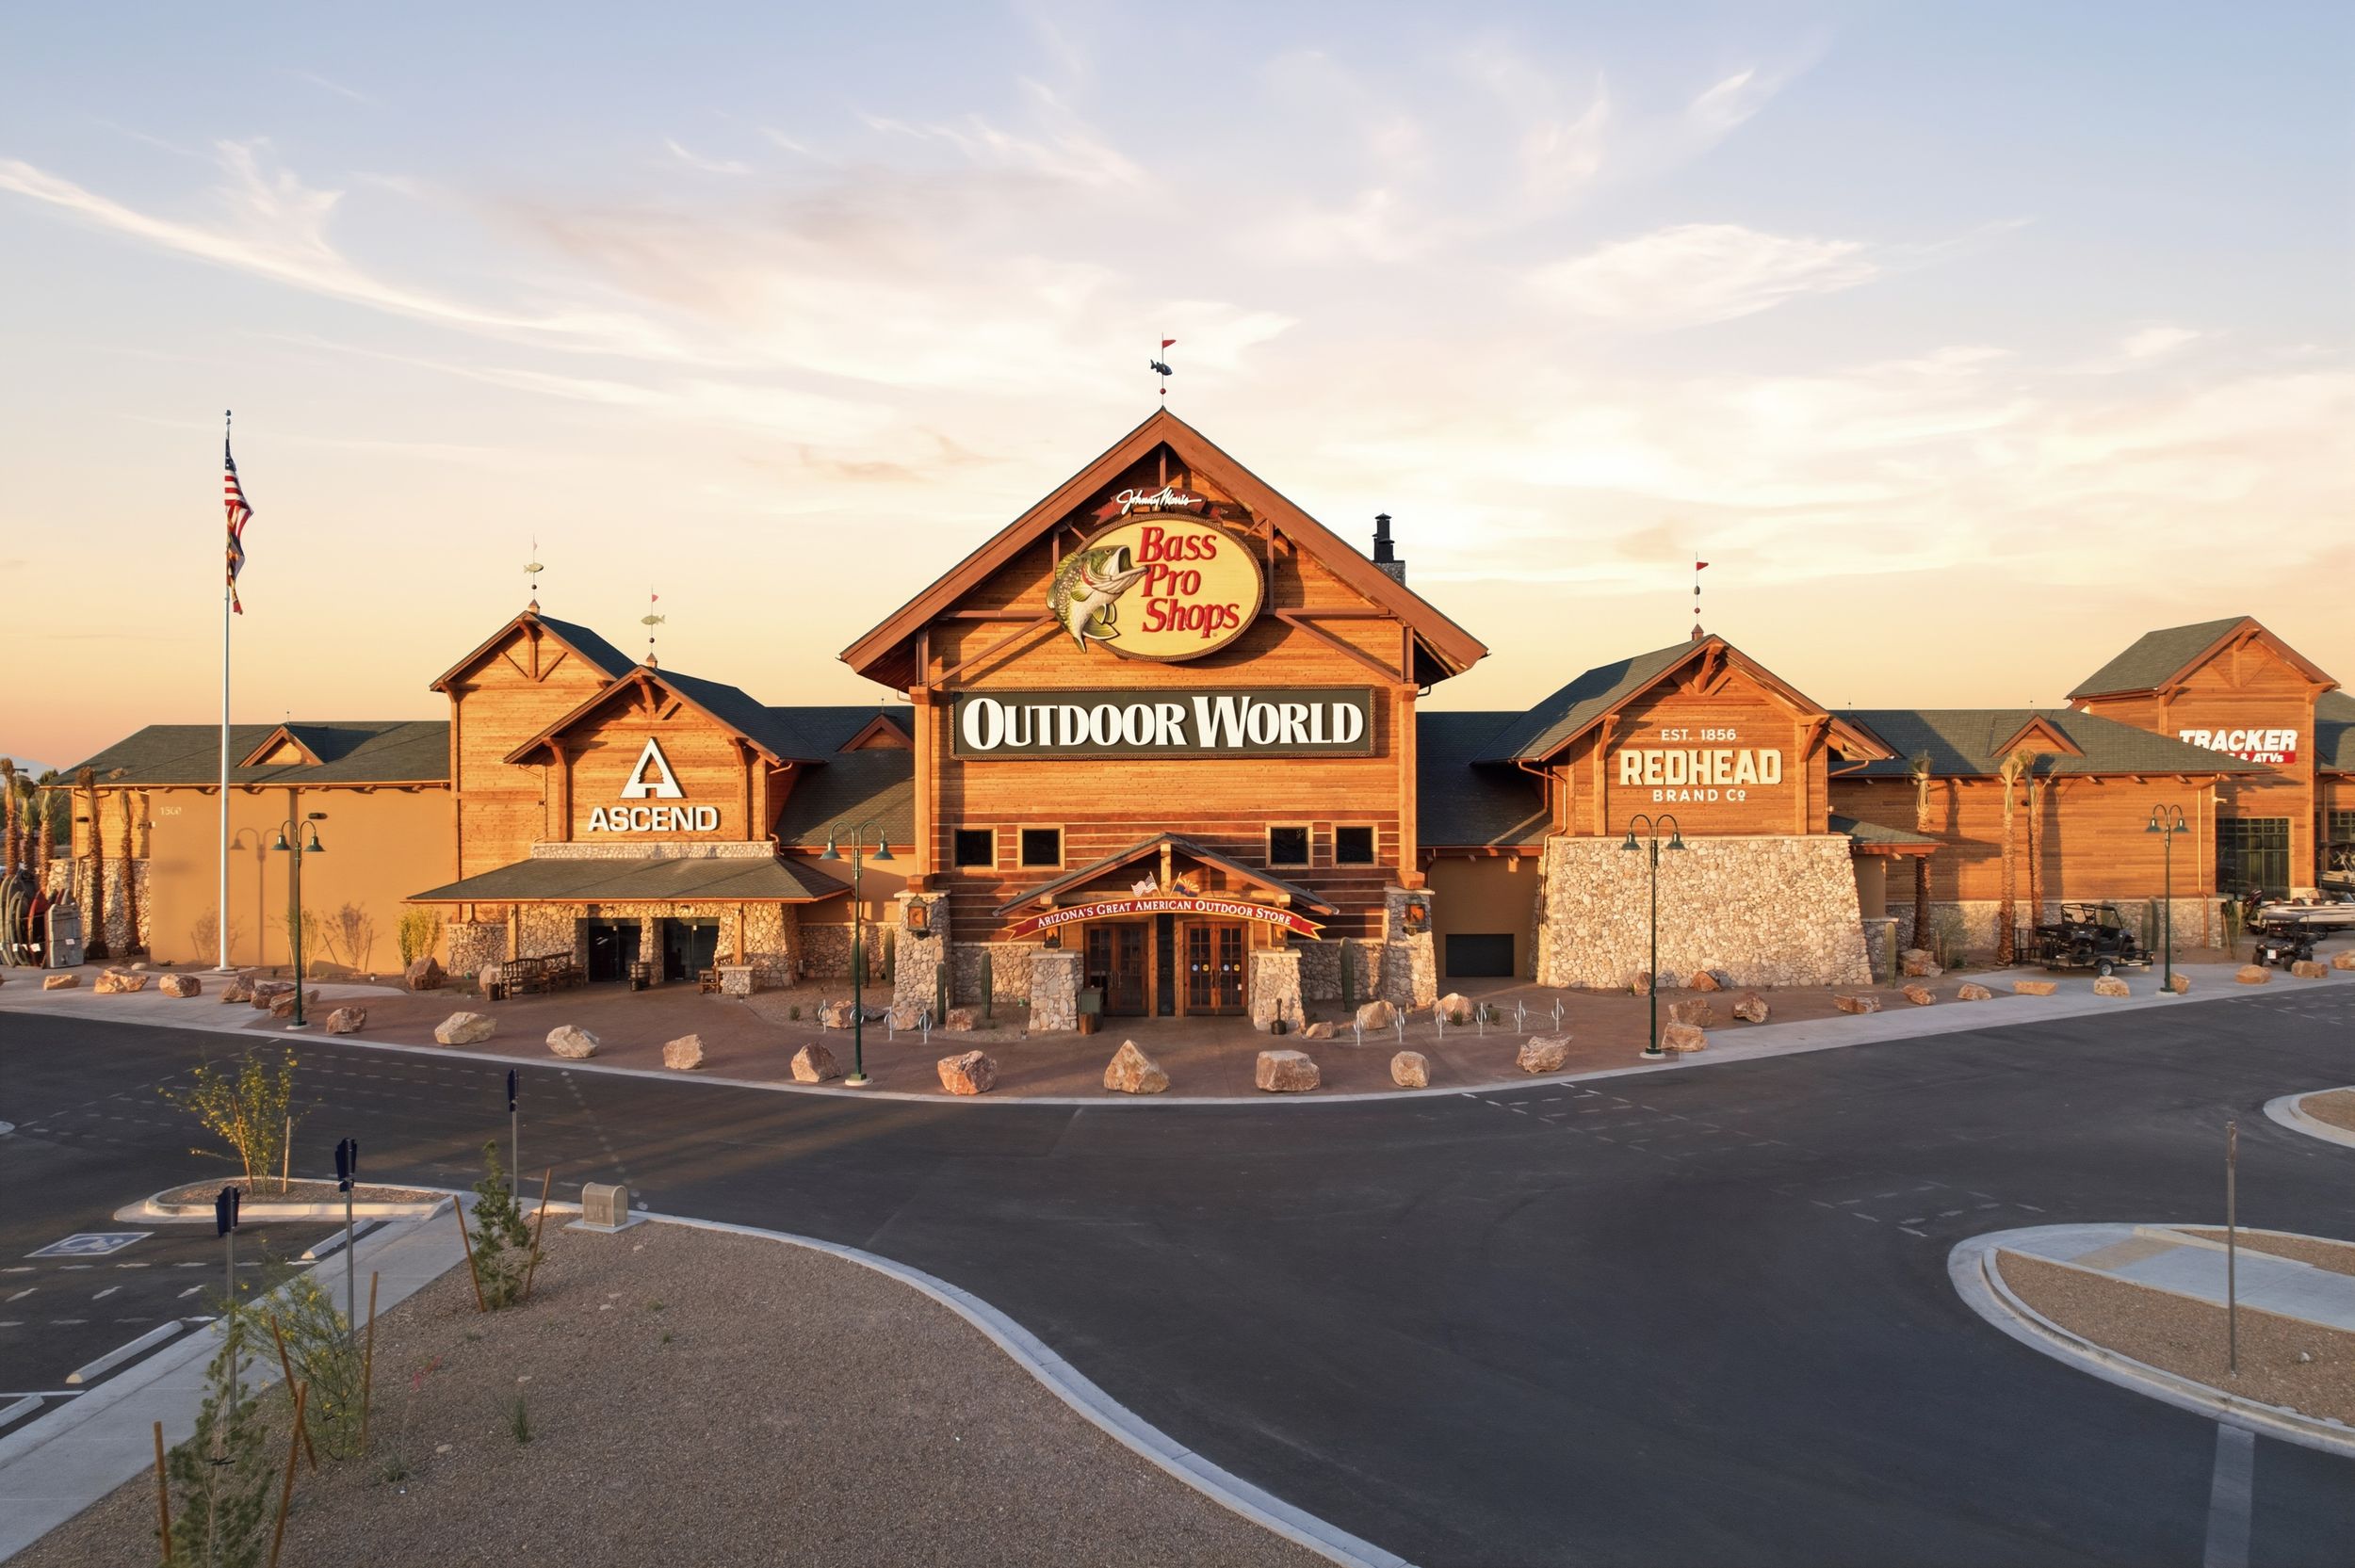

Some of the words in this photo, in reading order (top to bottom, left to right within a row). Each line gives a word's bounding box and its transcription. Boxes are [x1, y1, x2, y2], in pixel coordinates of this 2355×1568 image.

[1136, 526, 1217, 562] Bass
[1141, 563, 1201, 597] Pro
[1142, 598, 1240, 639] Shops
[963, 698, 1188, 750] OUTDOOR
[1192, 696, 1364, 748] WORLD
[1661, 729, 1693, 741] EST.
[1700, 728, 1737, 741] 1856
[2179, 730, 2298, 752] TRACKER
[1619, 750, 1782, 785] REDHEAD
[2252, 752, 2284, 763] ATVs
[1652, 789, 1718, 801] BRAND
[588, 806, 719, 832] ASCEND
[1037, 907, 1094, 929] ARIZONA'S
[1096, 902, 1131, 915] GREAT
[1135, 899, 1192, 912] AMERICAN
[1195, 900, 1253, 917] OUTDOOR
[1255, 907, 1292, 925] STORE
